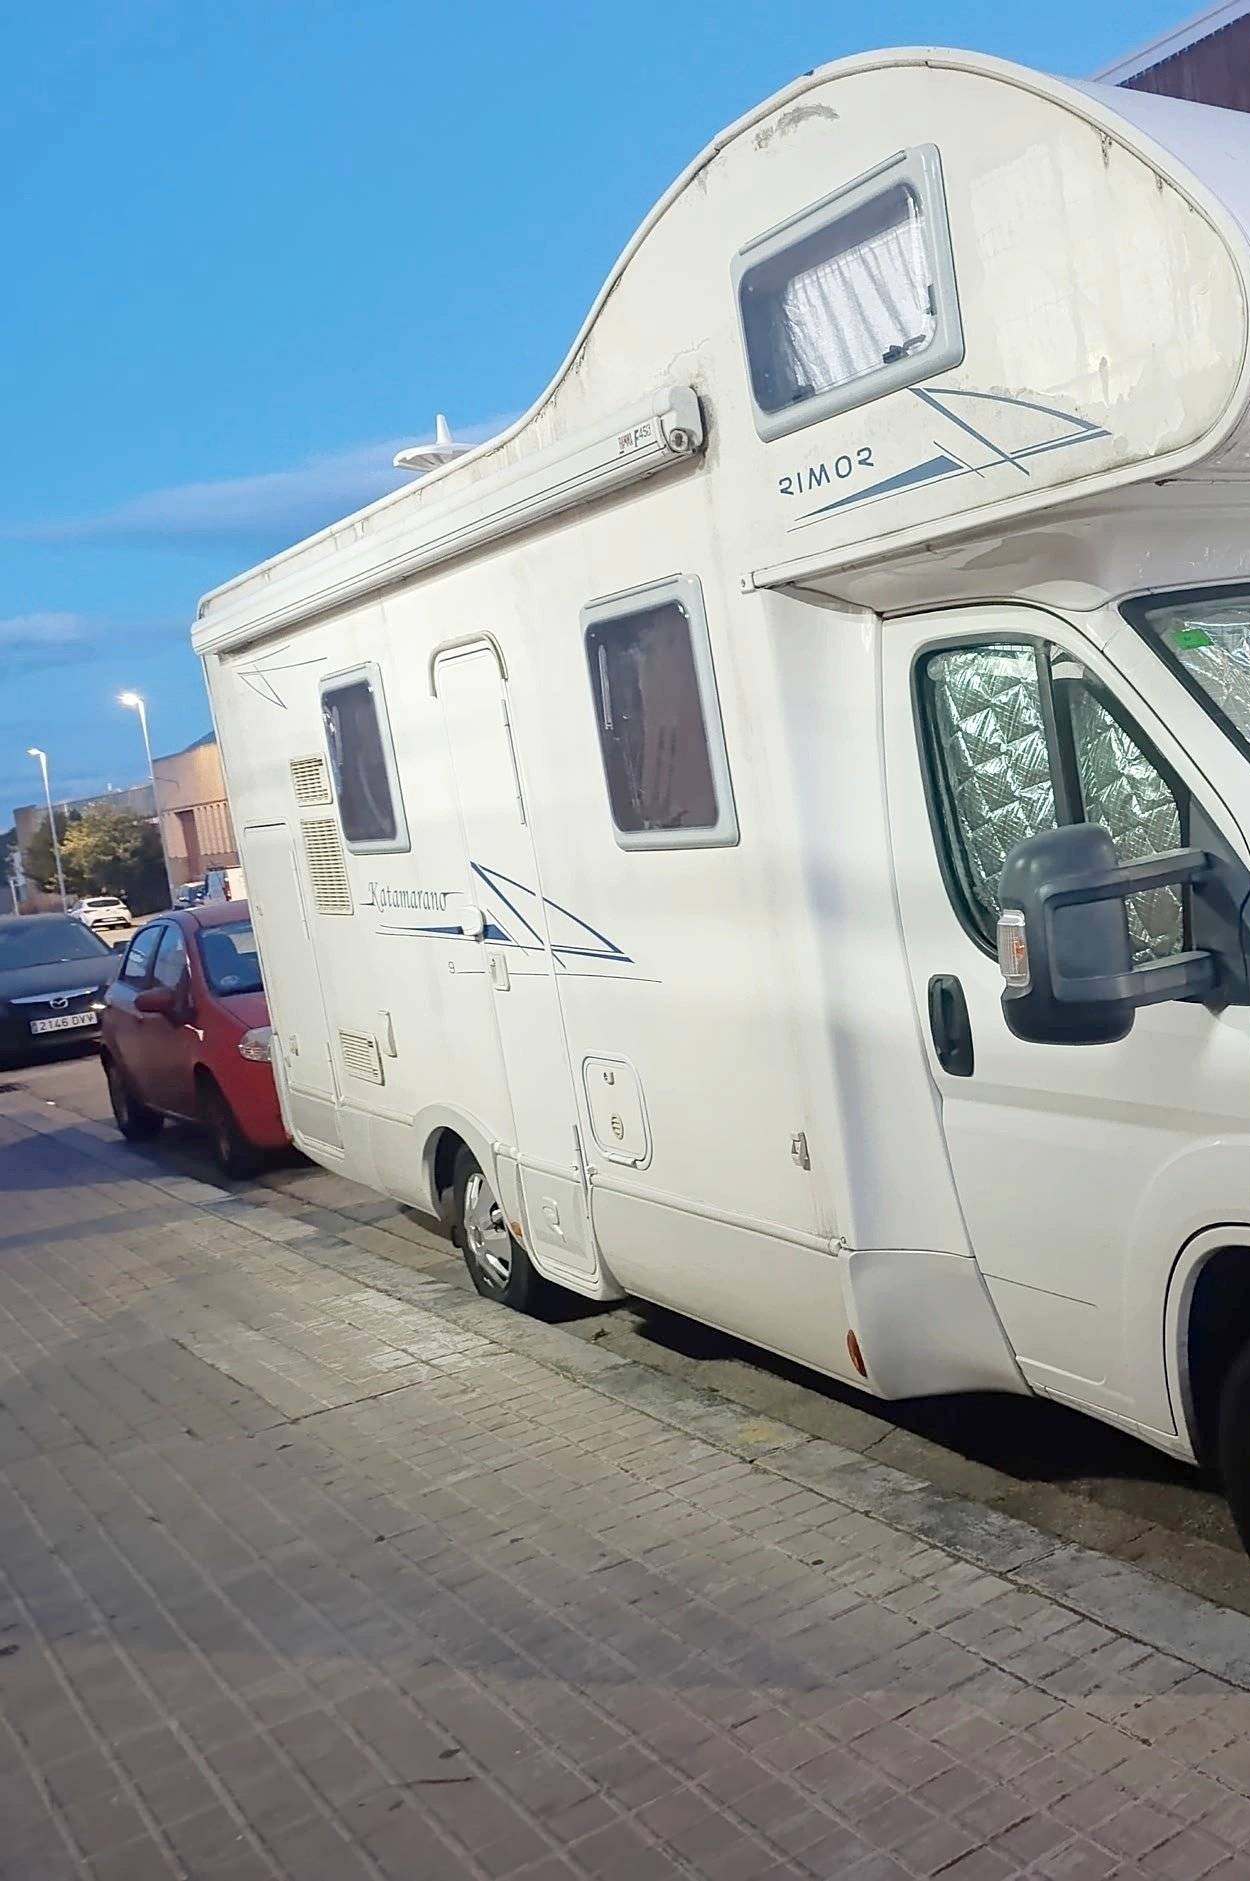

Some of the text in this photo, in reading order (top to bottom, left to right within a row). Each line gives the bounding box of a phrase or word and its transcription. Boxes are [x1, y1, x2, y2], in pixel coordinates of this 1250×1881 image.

[778, 446, 875, 496] RIMOR
[361, 881, 463, 913] Katamarano
[39, 1017, 69, 1031] 2146
